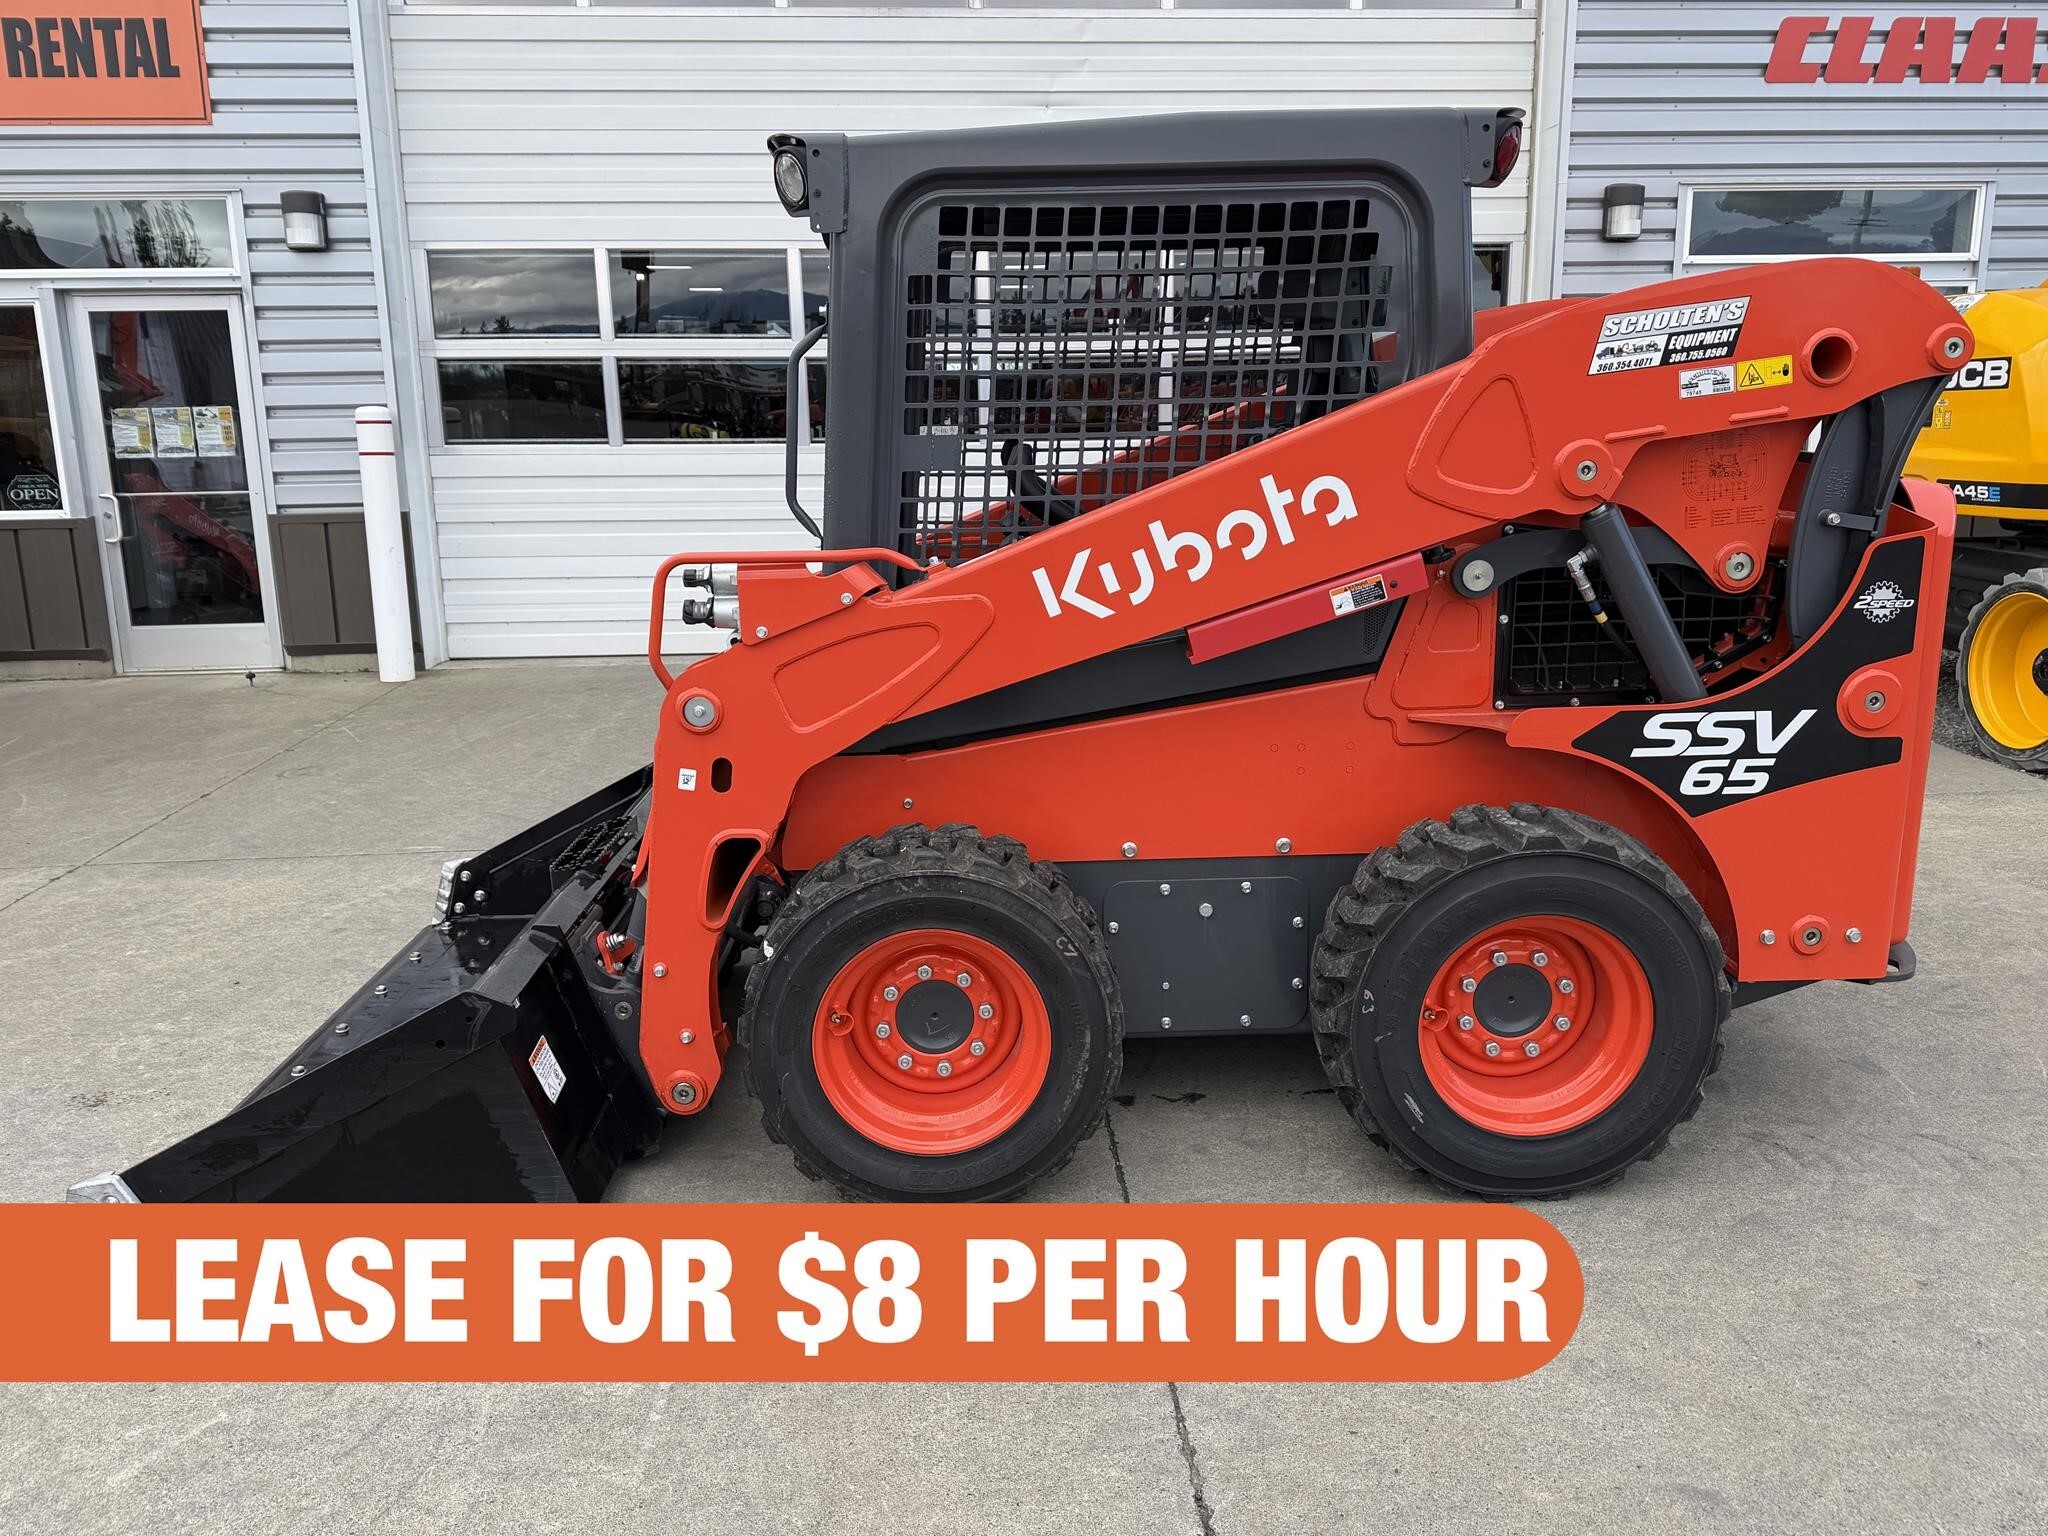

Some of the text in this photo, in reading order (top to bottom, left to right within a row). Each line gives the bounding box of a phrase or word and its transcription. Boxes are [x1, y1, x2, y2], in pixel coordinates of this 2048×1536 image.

[0, 17, 181, 78] RENTAL
[1764, 16, 2048, 84] CLAA
[1603, 301, 1744, 337] SCHOLTEN'S
[1668, 327, 1739, 350] EQUIPMENT
[1669, 346, 1729, 363] 360.755.0560
[1596, 357, 1653, 373] 360.354.4071
[10, 489, 59, 500] OPEN
[1031, 474, 1358, 619] Kubota
[1630, 709, 1818, 758] SSV
[1679, 757, 1777, 796] 65
